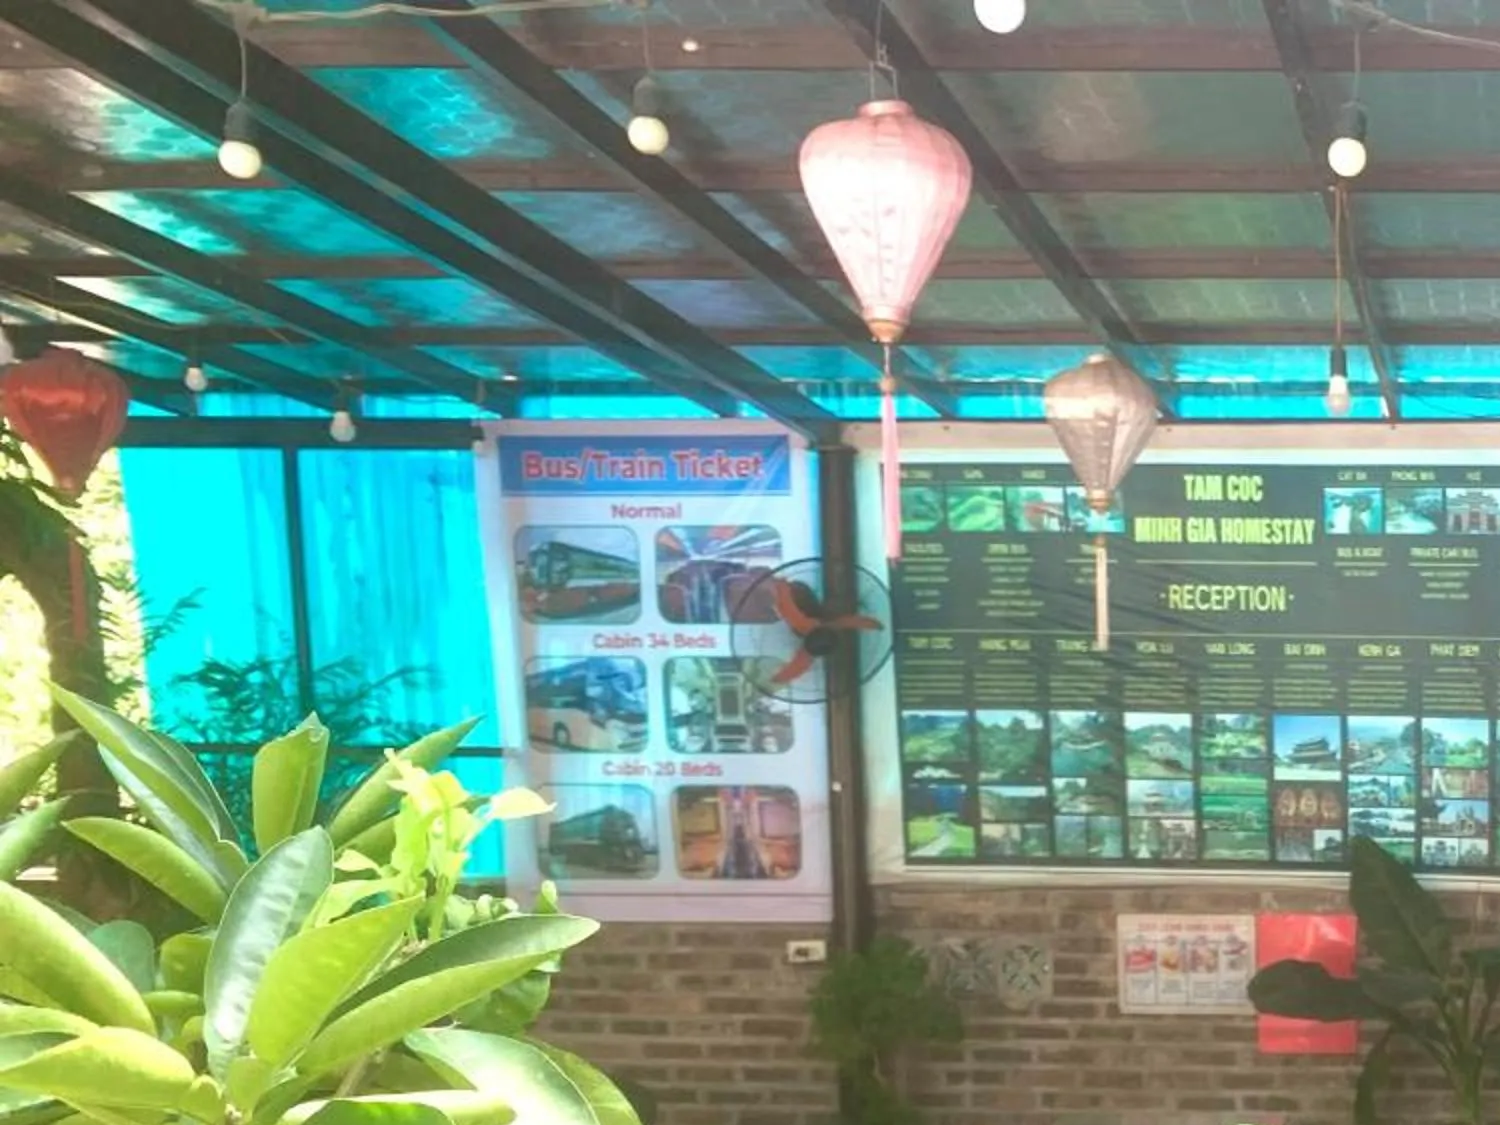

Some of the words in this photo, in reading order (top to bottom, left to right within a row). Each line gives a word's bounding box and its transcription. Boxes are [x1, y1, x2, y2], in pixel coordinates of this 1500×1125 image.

[522, 449, 663, 482] Bus/Train
[674, 449, 765, 480] Ticket
[1184, 475, 1224, 500] TAM
[1227, 475, 1264, 501] COC
[612, 503, 682, 520] Normal
[1187, 517, 1217, 542] GIA
[1221, 518, 1315, 544] HOMESTAY
[1168, 585, 1287, 611] RECEPTION
[593, 632, 643, 650] Cabin
[674, 633, 717, 650] Beds
[602, 760, 650, 777] Cabin
[681, 762, 723, 777] Beds
